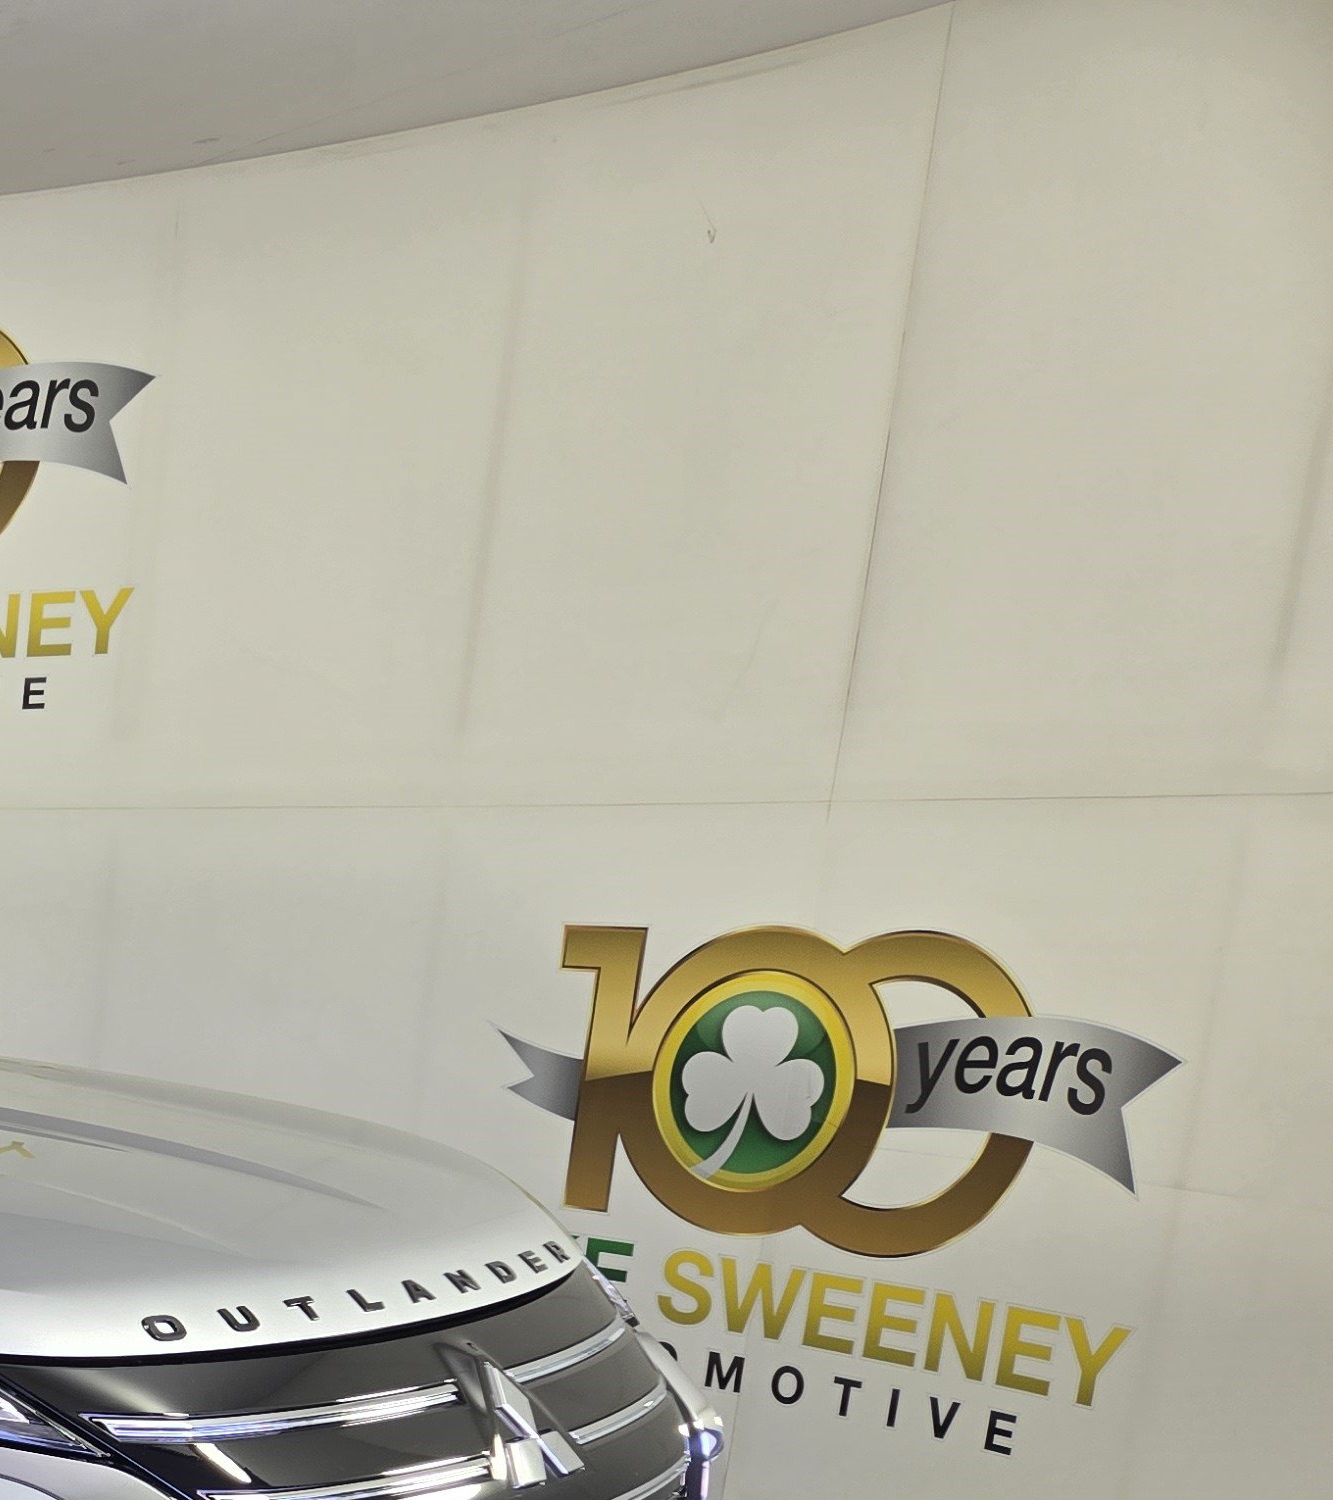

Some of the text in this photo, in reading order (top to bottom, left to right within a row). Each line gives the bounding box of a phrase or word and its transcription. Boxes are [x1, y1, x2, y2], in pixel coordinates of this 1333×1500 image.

[904, 1036, 1113, 1116] years
[140, 1239, 571, 1342] OUTLANDER
[657, 1249, 1131, 1407] SWEENEY
[659, 1341, 1018, 1456] MOTIVE
